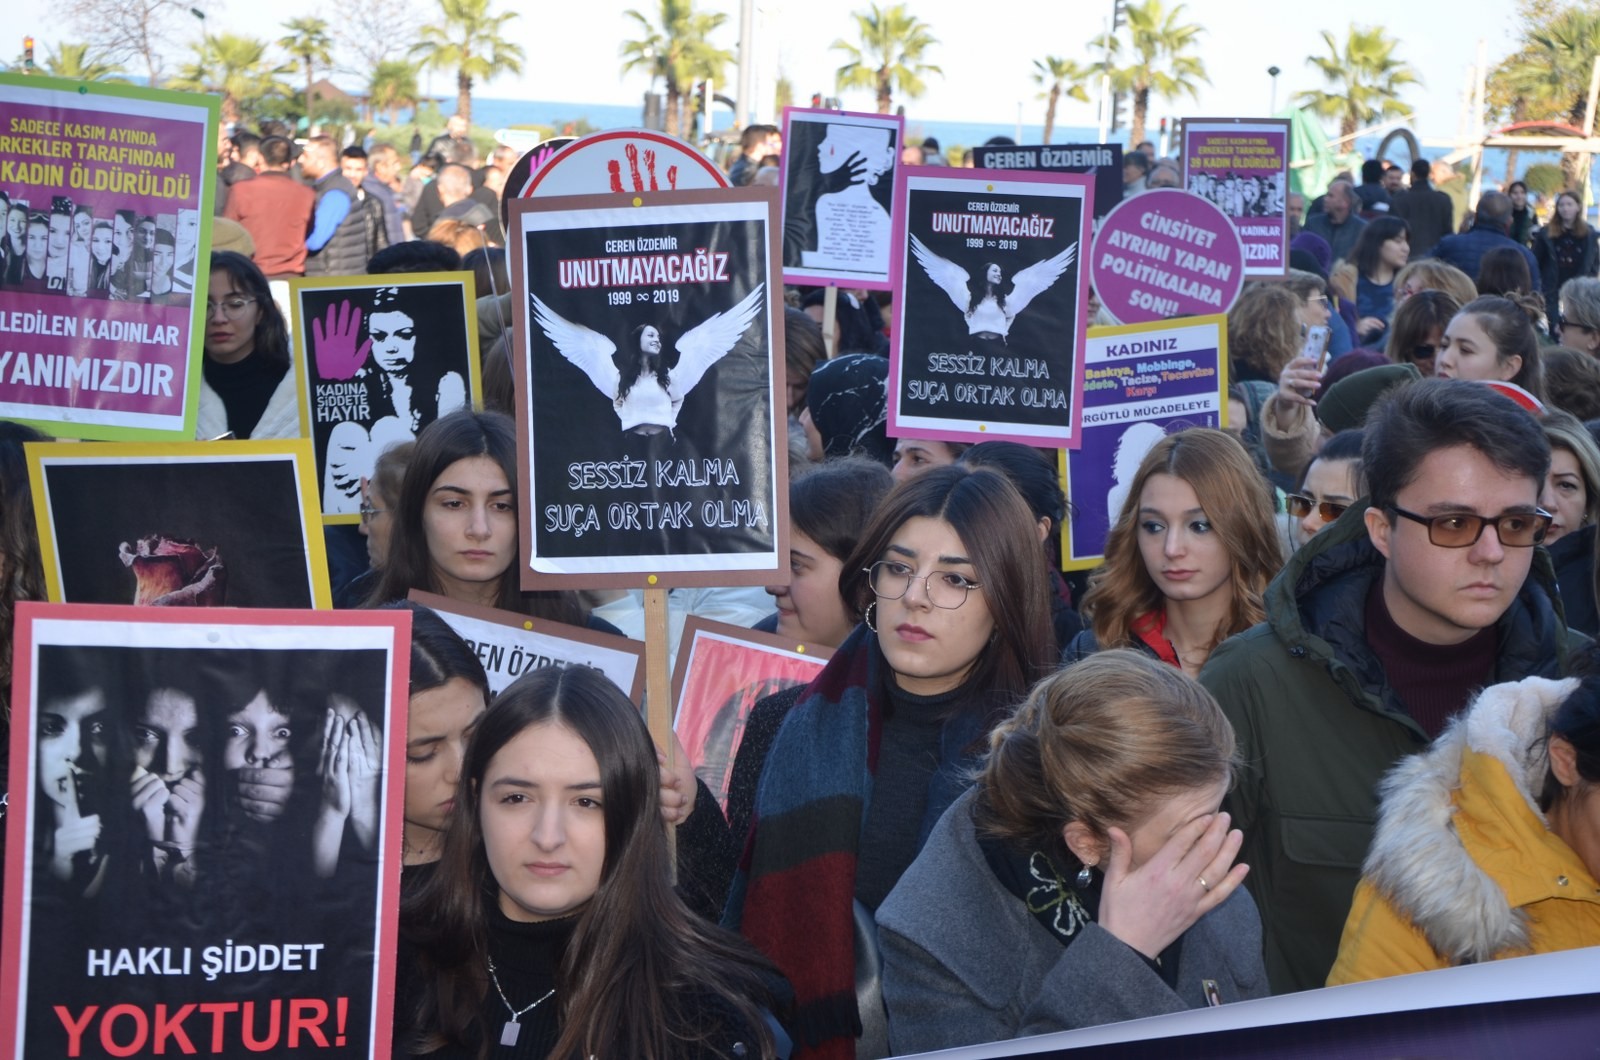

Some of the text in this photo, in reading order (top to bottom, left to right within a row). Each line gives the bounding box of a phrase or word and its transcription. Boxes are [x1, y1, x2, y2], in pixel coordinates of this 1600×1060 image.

[10, 117, 157, 146] SADECE KASIM AYINDA
[77, 142, 175, 169] TARAFINDAN
[984, 146, 1113, 169] CEREN ÖZDEMİR
[1203, 158, 1231, 168] KADIN
[1, 160, 191, 200] KADIN ÖLDÜRÜLDÜ
[967, 202, 1020, 213] CEREN ÖZDEMİR
[932, 213, 1054, 239] UNUTMAYACAĞIZ
[1140, 209, 1217, 249] CİNSİYET
[1240, 226, 1281, 236] KADINLAR
[605, 235, 678, 253] CEREN ÖZDEMİR
[966, 238, 984, 248] 1999
[998, 240, 1018, 250] 2019
[1107, 229, 1232, 281] AYRIMI YAPAN
[558, 248, 729, 289] UNUTMAYACAĞIZ
[1100, 253, 1222, 307] POLİTİKALARA
[607, 291, 632, 305] 1999
[653, 289, 679, 303] 2019
[1128, 289, 1179, 316] SON!!
[83, 318, 179, 346] KADINLAR
[1106, 338, 1177, 357] KADINIZ
[927, 351, 1050, 379] SESSİZ KALMA
[316, 383, 368, 396] KADINA
[908, 380, 1068, 409] SUÇA ORTAK OLMA
[317, 405, 370, 422] HAYIR
[1082, 400, 1211, 423] RGÜTLÜ MÜCADELEYE
[568, 455, 740, 490] SESSİZ KALMA
[545, 500, 769, 537] SUÇA ORTAK OLMA
[88, 940, 324, 980] HAKLI ŞİDDET
[53, 997, 349, 1058] YOKTUR!
